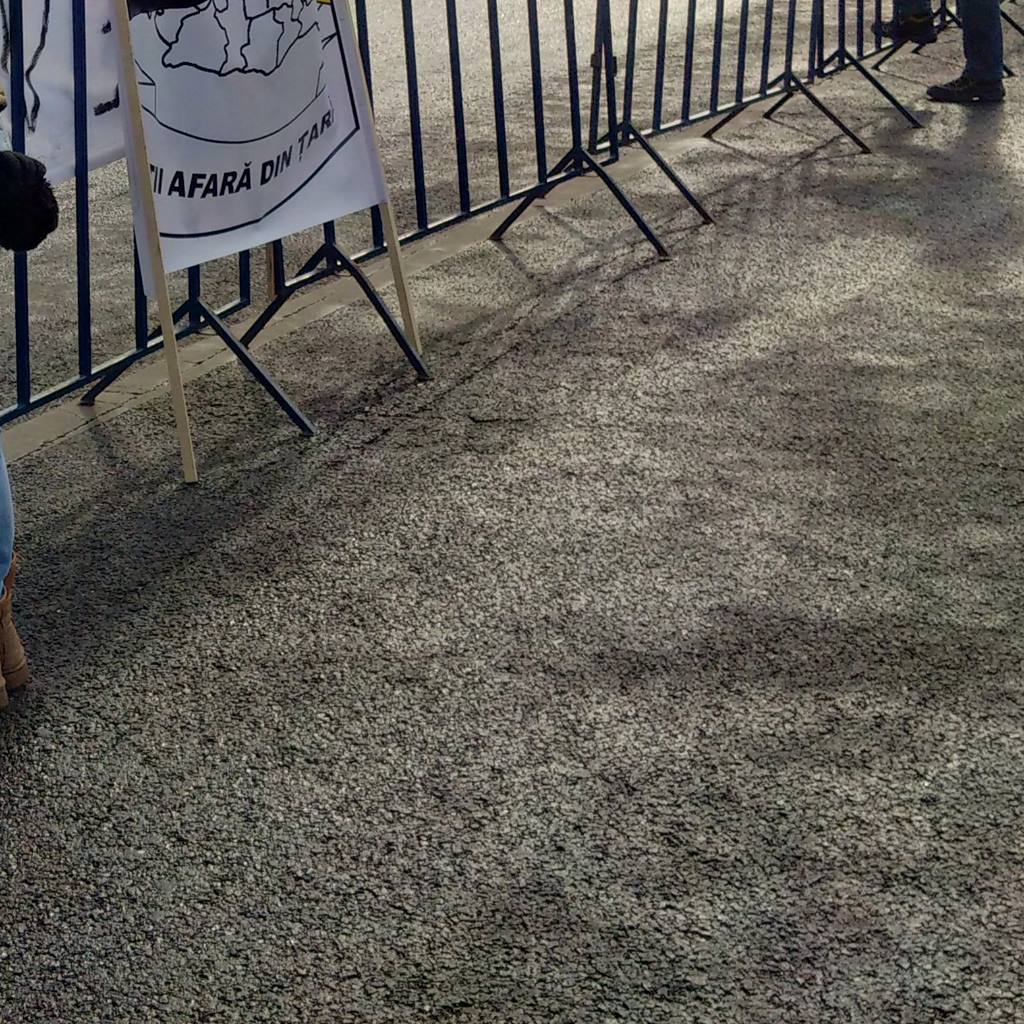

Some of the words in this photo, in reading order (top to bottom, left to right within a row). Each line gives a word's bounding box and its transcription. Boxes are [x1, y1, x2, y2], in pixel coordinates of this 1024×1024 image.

[167, 161, 253, 199] AFARĂ
[260, 145, 293, 186] DIN
[297, 95, 335, 163] ȚAR
